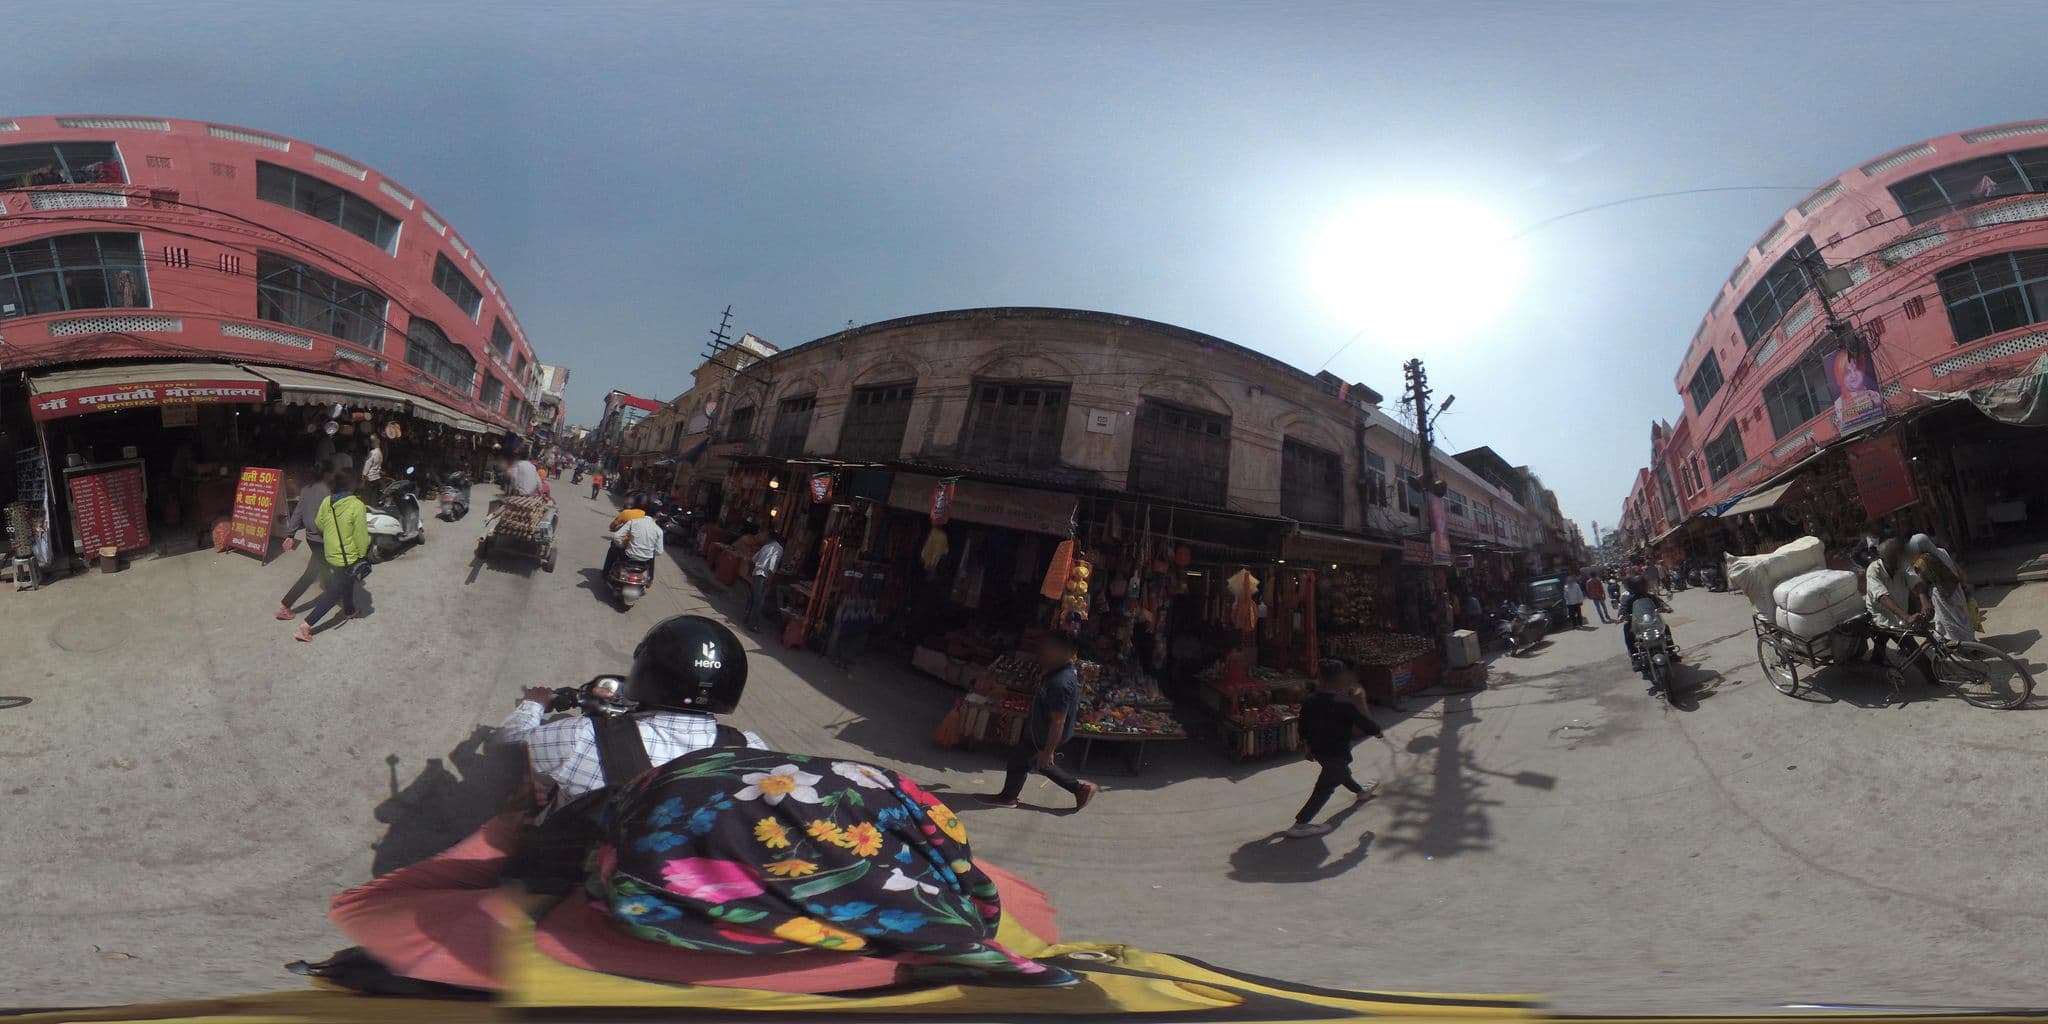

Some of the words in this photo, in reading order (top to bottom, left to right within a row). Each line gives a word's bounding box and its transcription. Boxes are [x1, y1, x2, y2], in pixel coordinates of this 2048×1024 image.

[118, 383, 197, 391] WELCOME
[78, 388, 156, 404] भगवती
[165, 386, 262, 397] भोजनालय
[694, 659, 722, 669] Hero
